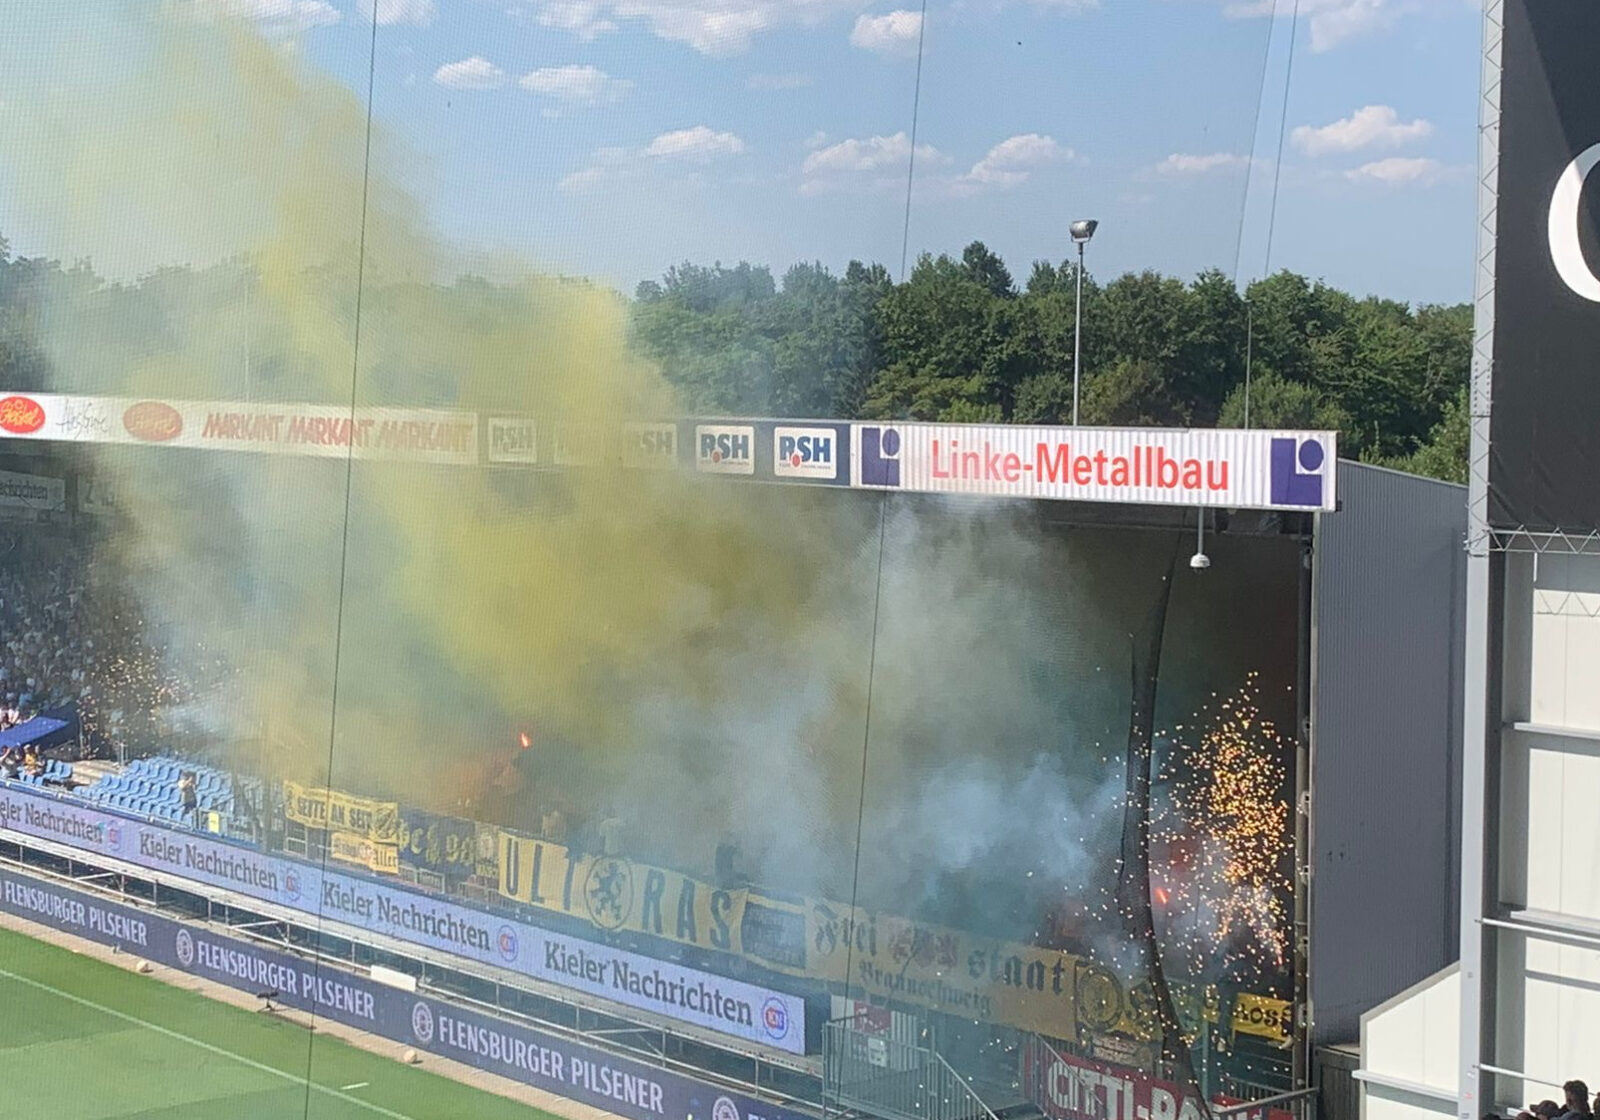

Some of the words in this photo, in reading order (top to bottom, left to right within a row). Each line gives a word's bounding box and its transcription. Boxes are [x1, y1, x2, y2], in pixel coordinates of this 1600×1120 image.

[287, 415, 374, 447] MARKANT
[701, 433, 749, 459] RSH
[779, 435, 831, 462] RSH
[932, 439, 1229, 491] Linke-Metallbau
[25, 802, 102, 844] Nachrichten
[140, 832, 181, 863] Kieler
[186, 843, 278, 891] Nachrichten
[5, 880, 86, 927] FLENSBURGER
[89, 906, 147, 946] PILSENER
[323, 880, 373, 918] Kieler
[377, 894, 490, 951] Nachrichten
[198, 941, 298, 995] FLENSBURGER
[302, 972, 375, 1020] PILSENER
[545, 939, 606, 985] Kieler
[612, 961, 752, 1027] Nachrichten
[439, 1015, 564, 1082] FLENSBURGER
[571, 1056, 664, 1115] PILSENER
